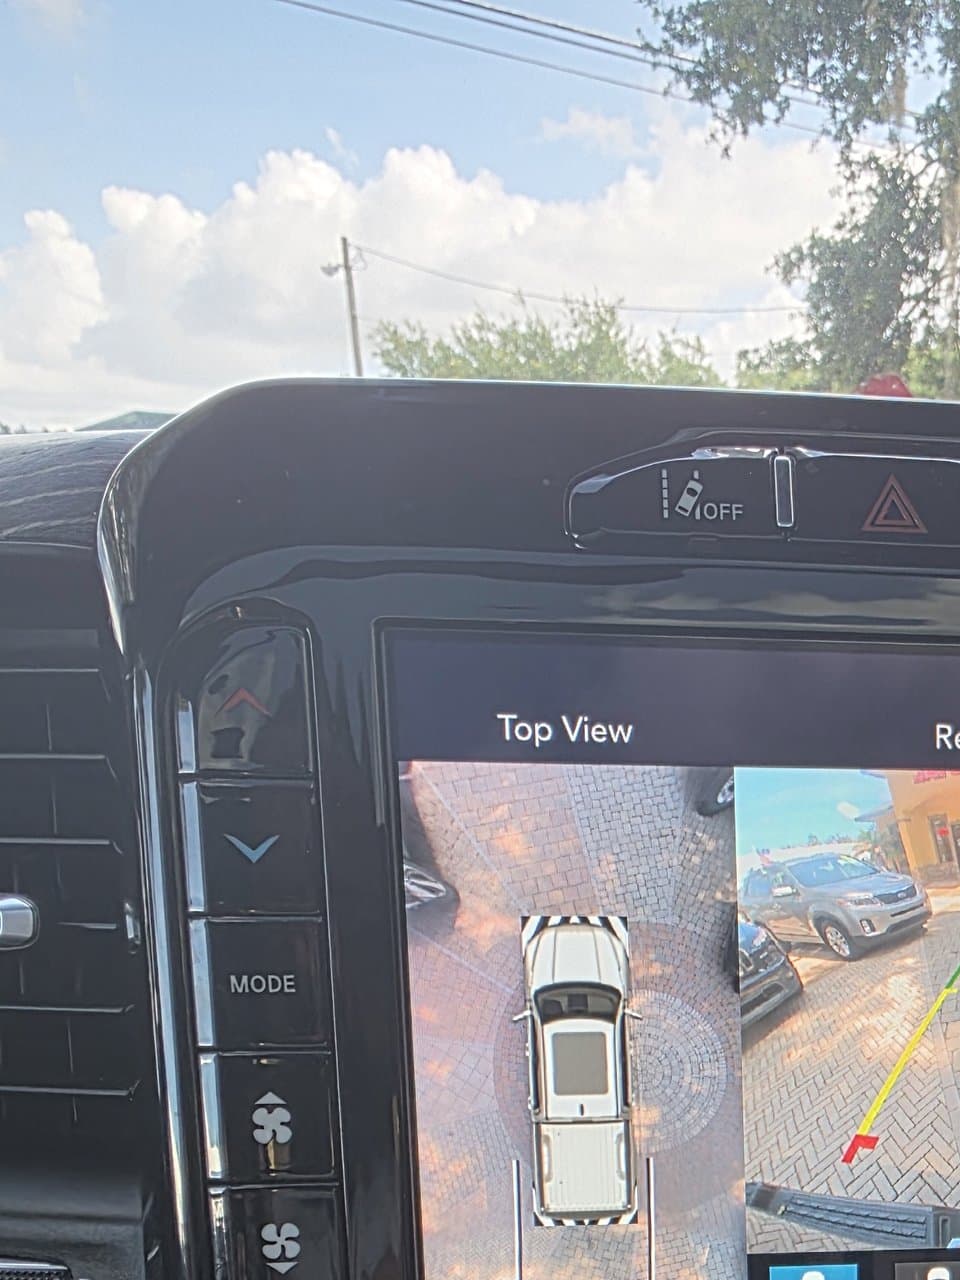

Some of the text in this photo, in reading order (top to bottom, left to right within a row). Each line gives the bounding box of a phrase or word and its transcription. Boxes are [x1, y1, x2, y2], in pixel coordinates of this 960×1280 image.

[703, 502, 744, 521] OFF
[496, 713, 633, 748] Top View
[230, 974, 297, 994] MODE
